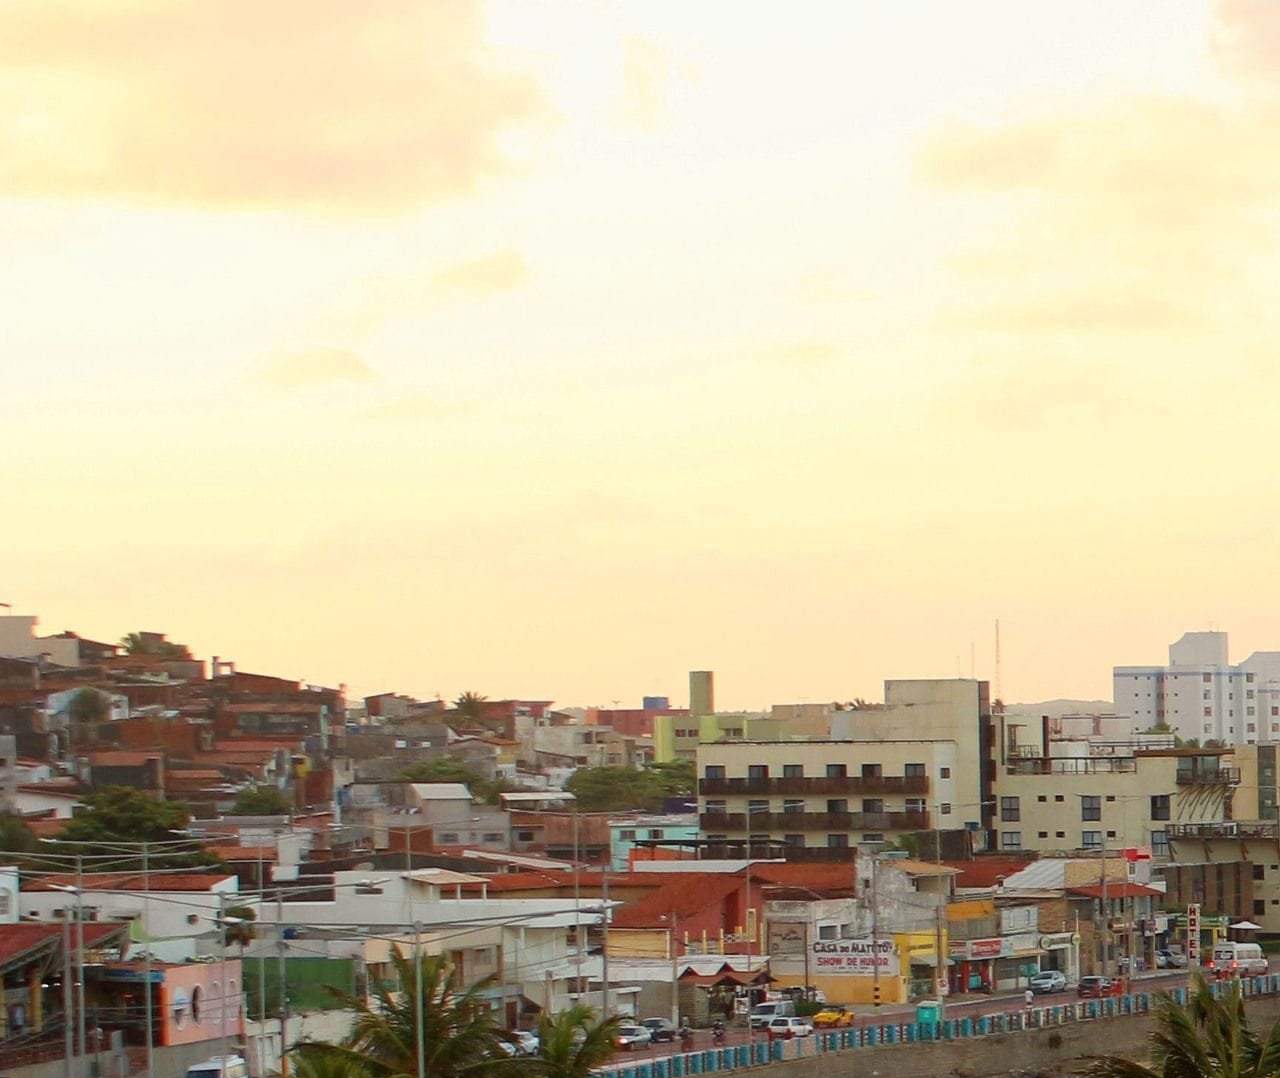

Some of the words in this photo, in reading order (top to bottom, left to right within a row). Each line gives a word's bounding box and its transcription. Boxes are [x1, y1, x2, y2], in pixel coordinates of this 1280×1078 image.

[1188, 907, 1197, 959] HOTEL
[813, 942, 838, 954] CASA
[851, 942, 890, 953] MATTO
[817, 957, 843, 966] SHOW
[847, 957, 858, 966] DE
